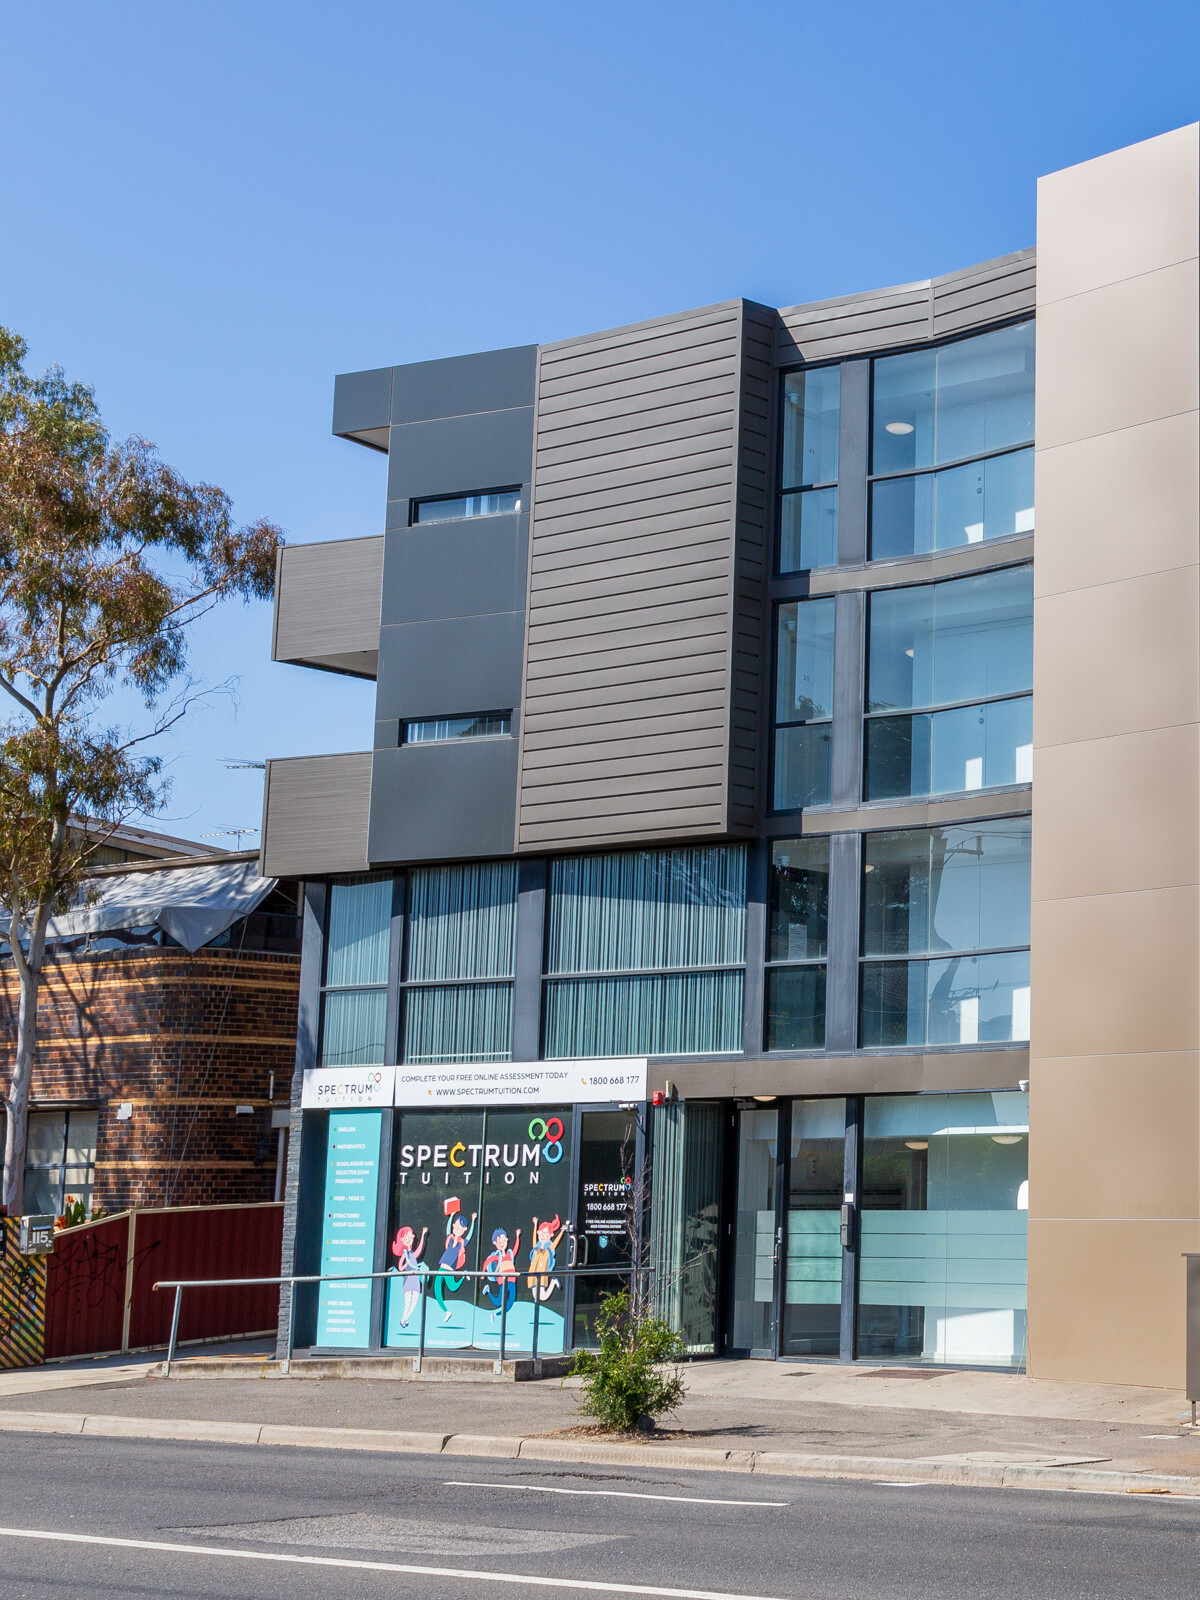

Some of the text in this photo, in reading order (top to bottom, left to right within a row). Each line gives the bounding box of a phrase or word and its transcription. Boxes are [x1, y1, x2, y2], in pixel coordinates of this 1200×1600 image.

[438, 1074, 455, 1082] YOUR
[474, 1073, 499, 1081] ONLINE
[499, 1072, 544, 1080] ASSESSMENT
[545, 1071, 568, 1079] TODAY
[589, 1075, 640, 1085] 1800 668 177
[318, 1084, 373, 1095] SPECTRUM
[436, 1087, 540, 1096] WWW.SPECTRUMTUITION.COM
[400, 1142, 541, 1168] SPECTRUM
[400, 1172, 540, 1184] TUITION
[584, 1183, 625, 1191] SPECTRUM
[32, 1231, 49, 1244] 115
